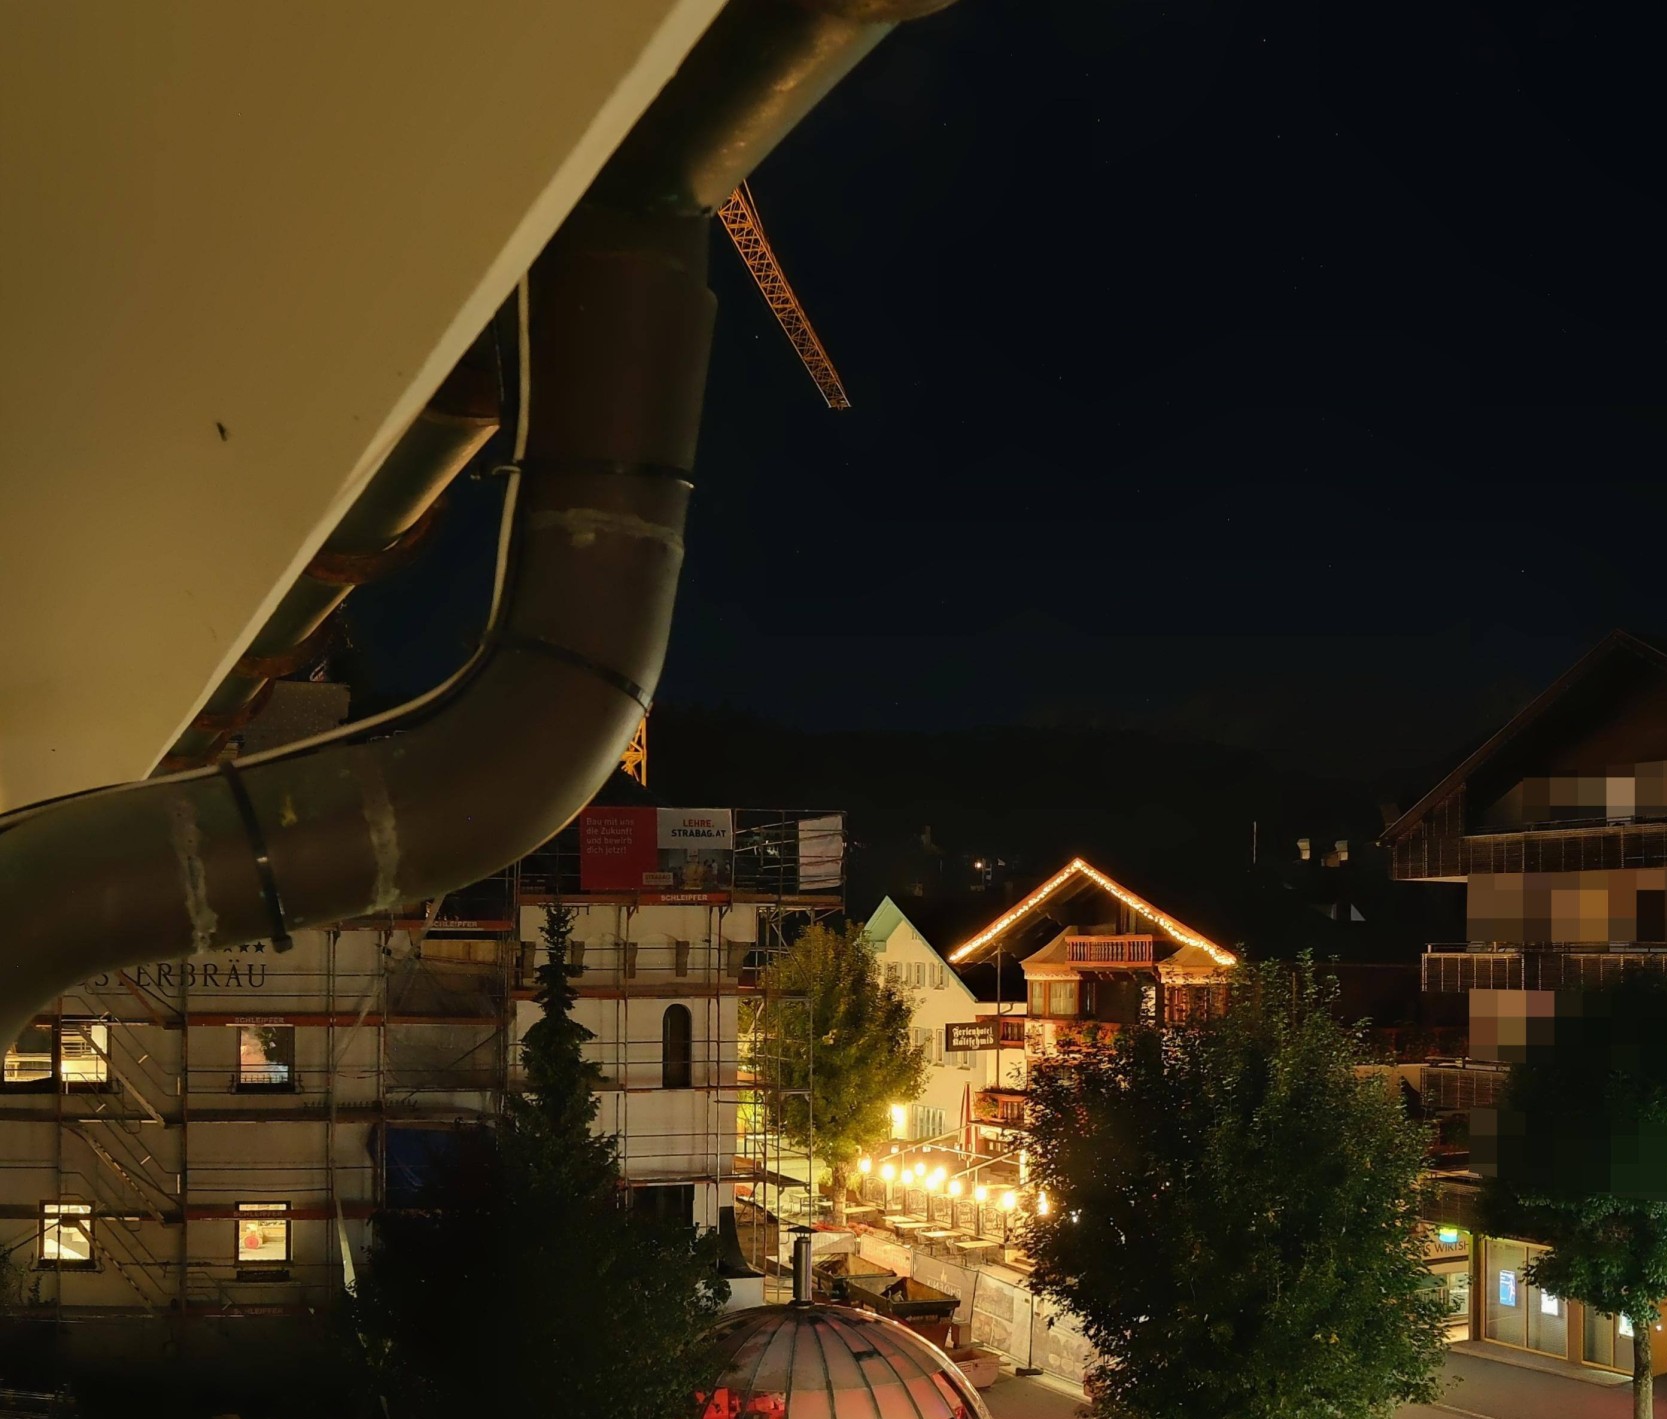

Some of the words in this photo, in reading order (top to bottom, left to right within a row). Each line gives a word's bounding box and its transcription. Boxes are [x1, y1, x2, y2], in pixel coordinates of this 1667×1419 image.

[603, 817, 618, 826] mit
[683, 819, 715, 828] LEHRE.
[671, 829, 726, 838] STRABAG.AT
